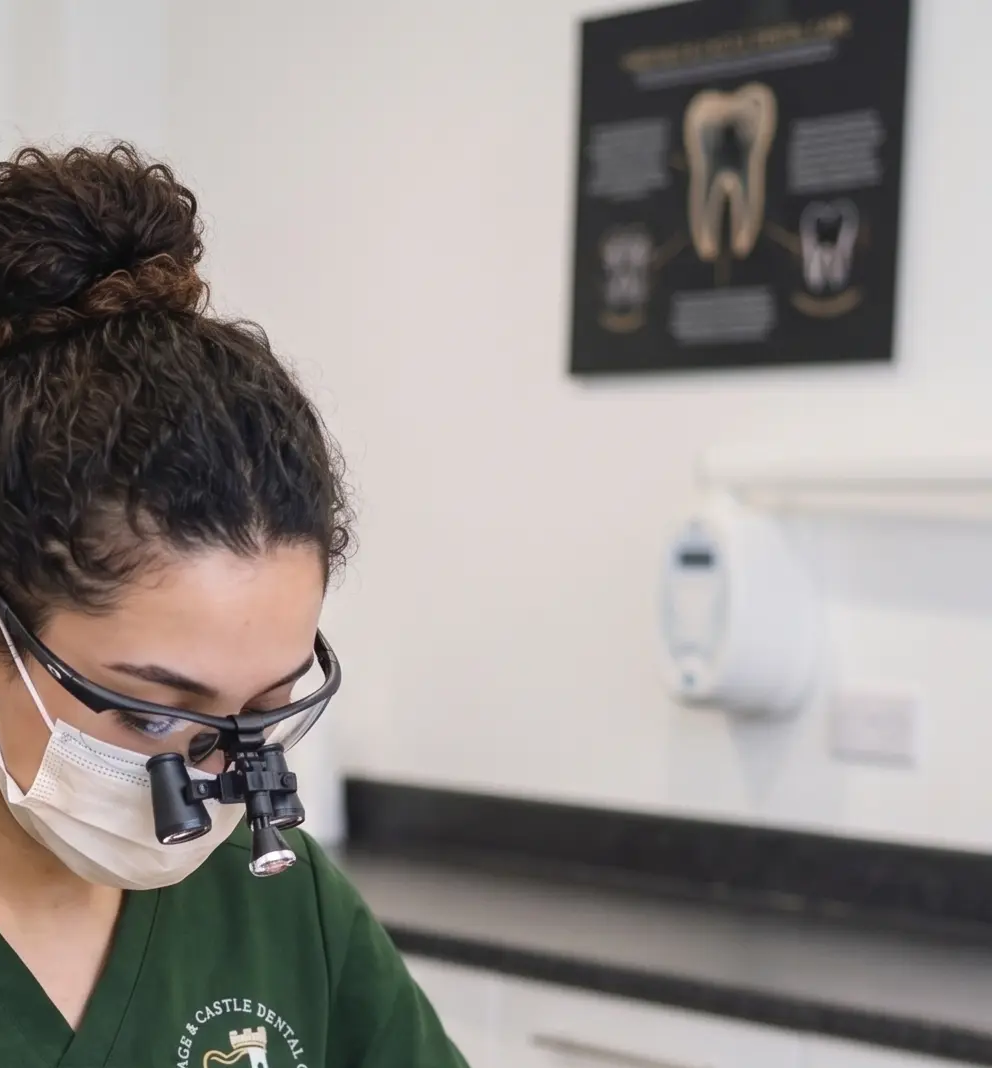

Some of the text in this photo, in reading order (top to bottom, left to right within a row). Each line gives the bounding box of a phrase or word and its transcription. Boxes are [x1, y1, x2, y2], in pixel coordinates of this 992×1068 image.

[185, 1023, 199, 1036] &
[195, 998, 252, 1024] CASTLE
[256, 1002, 304, 1060] DENTAL
